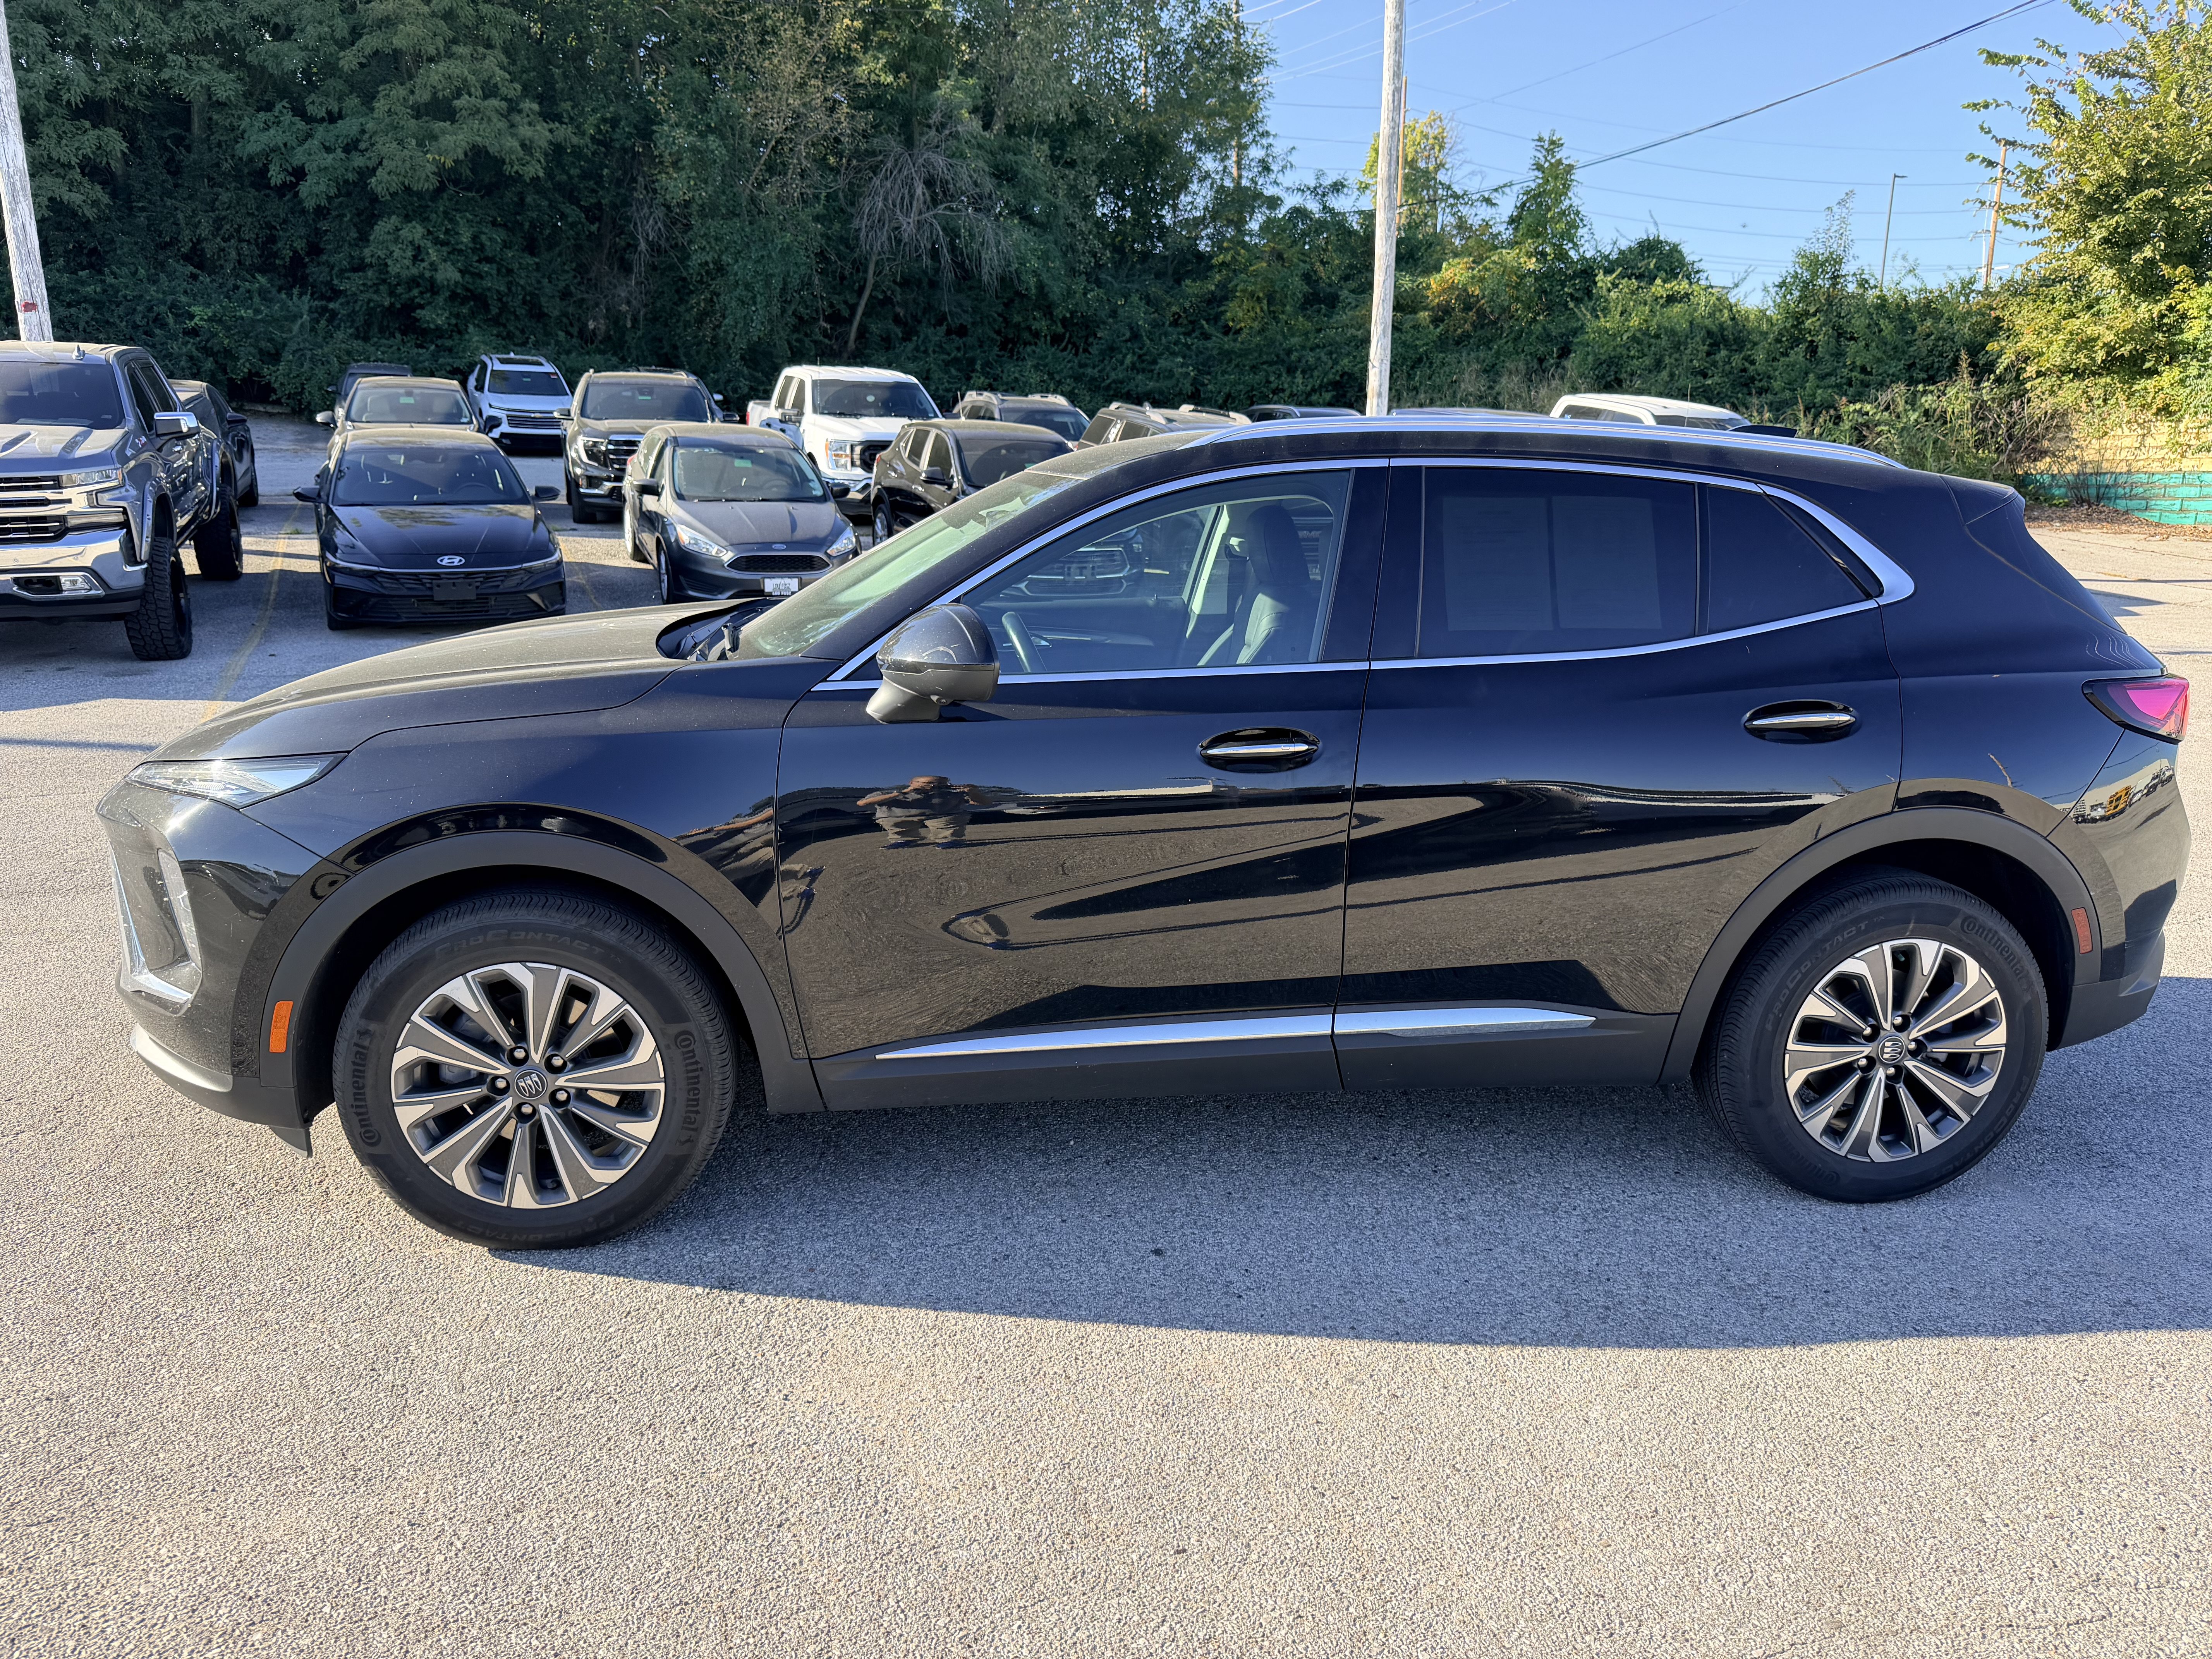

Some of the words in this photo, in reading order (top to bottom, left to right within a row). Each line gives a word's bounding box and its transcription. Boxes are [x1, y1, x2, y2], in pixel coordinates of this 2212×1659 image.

[1960, 915, 2029, 982] Continental
[350, 1042, 381, 1147] Continental
[674, 1030, 704, 1133] Continental
